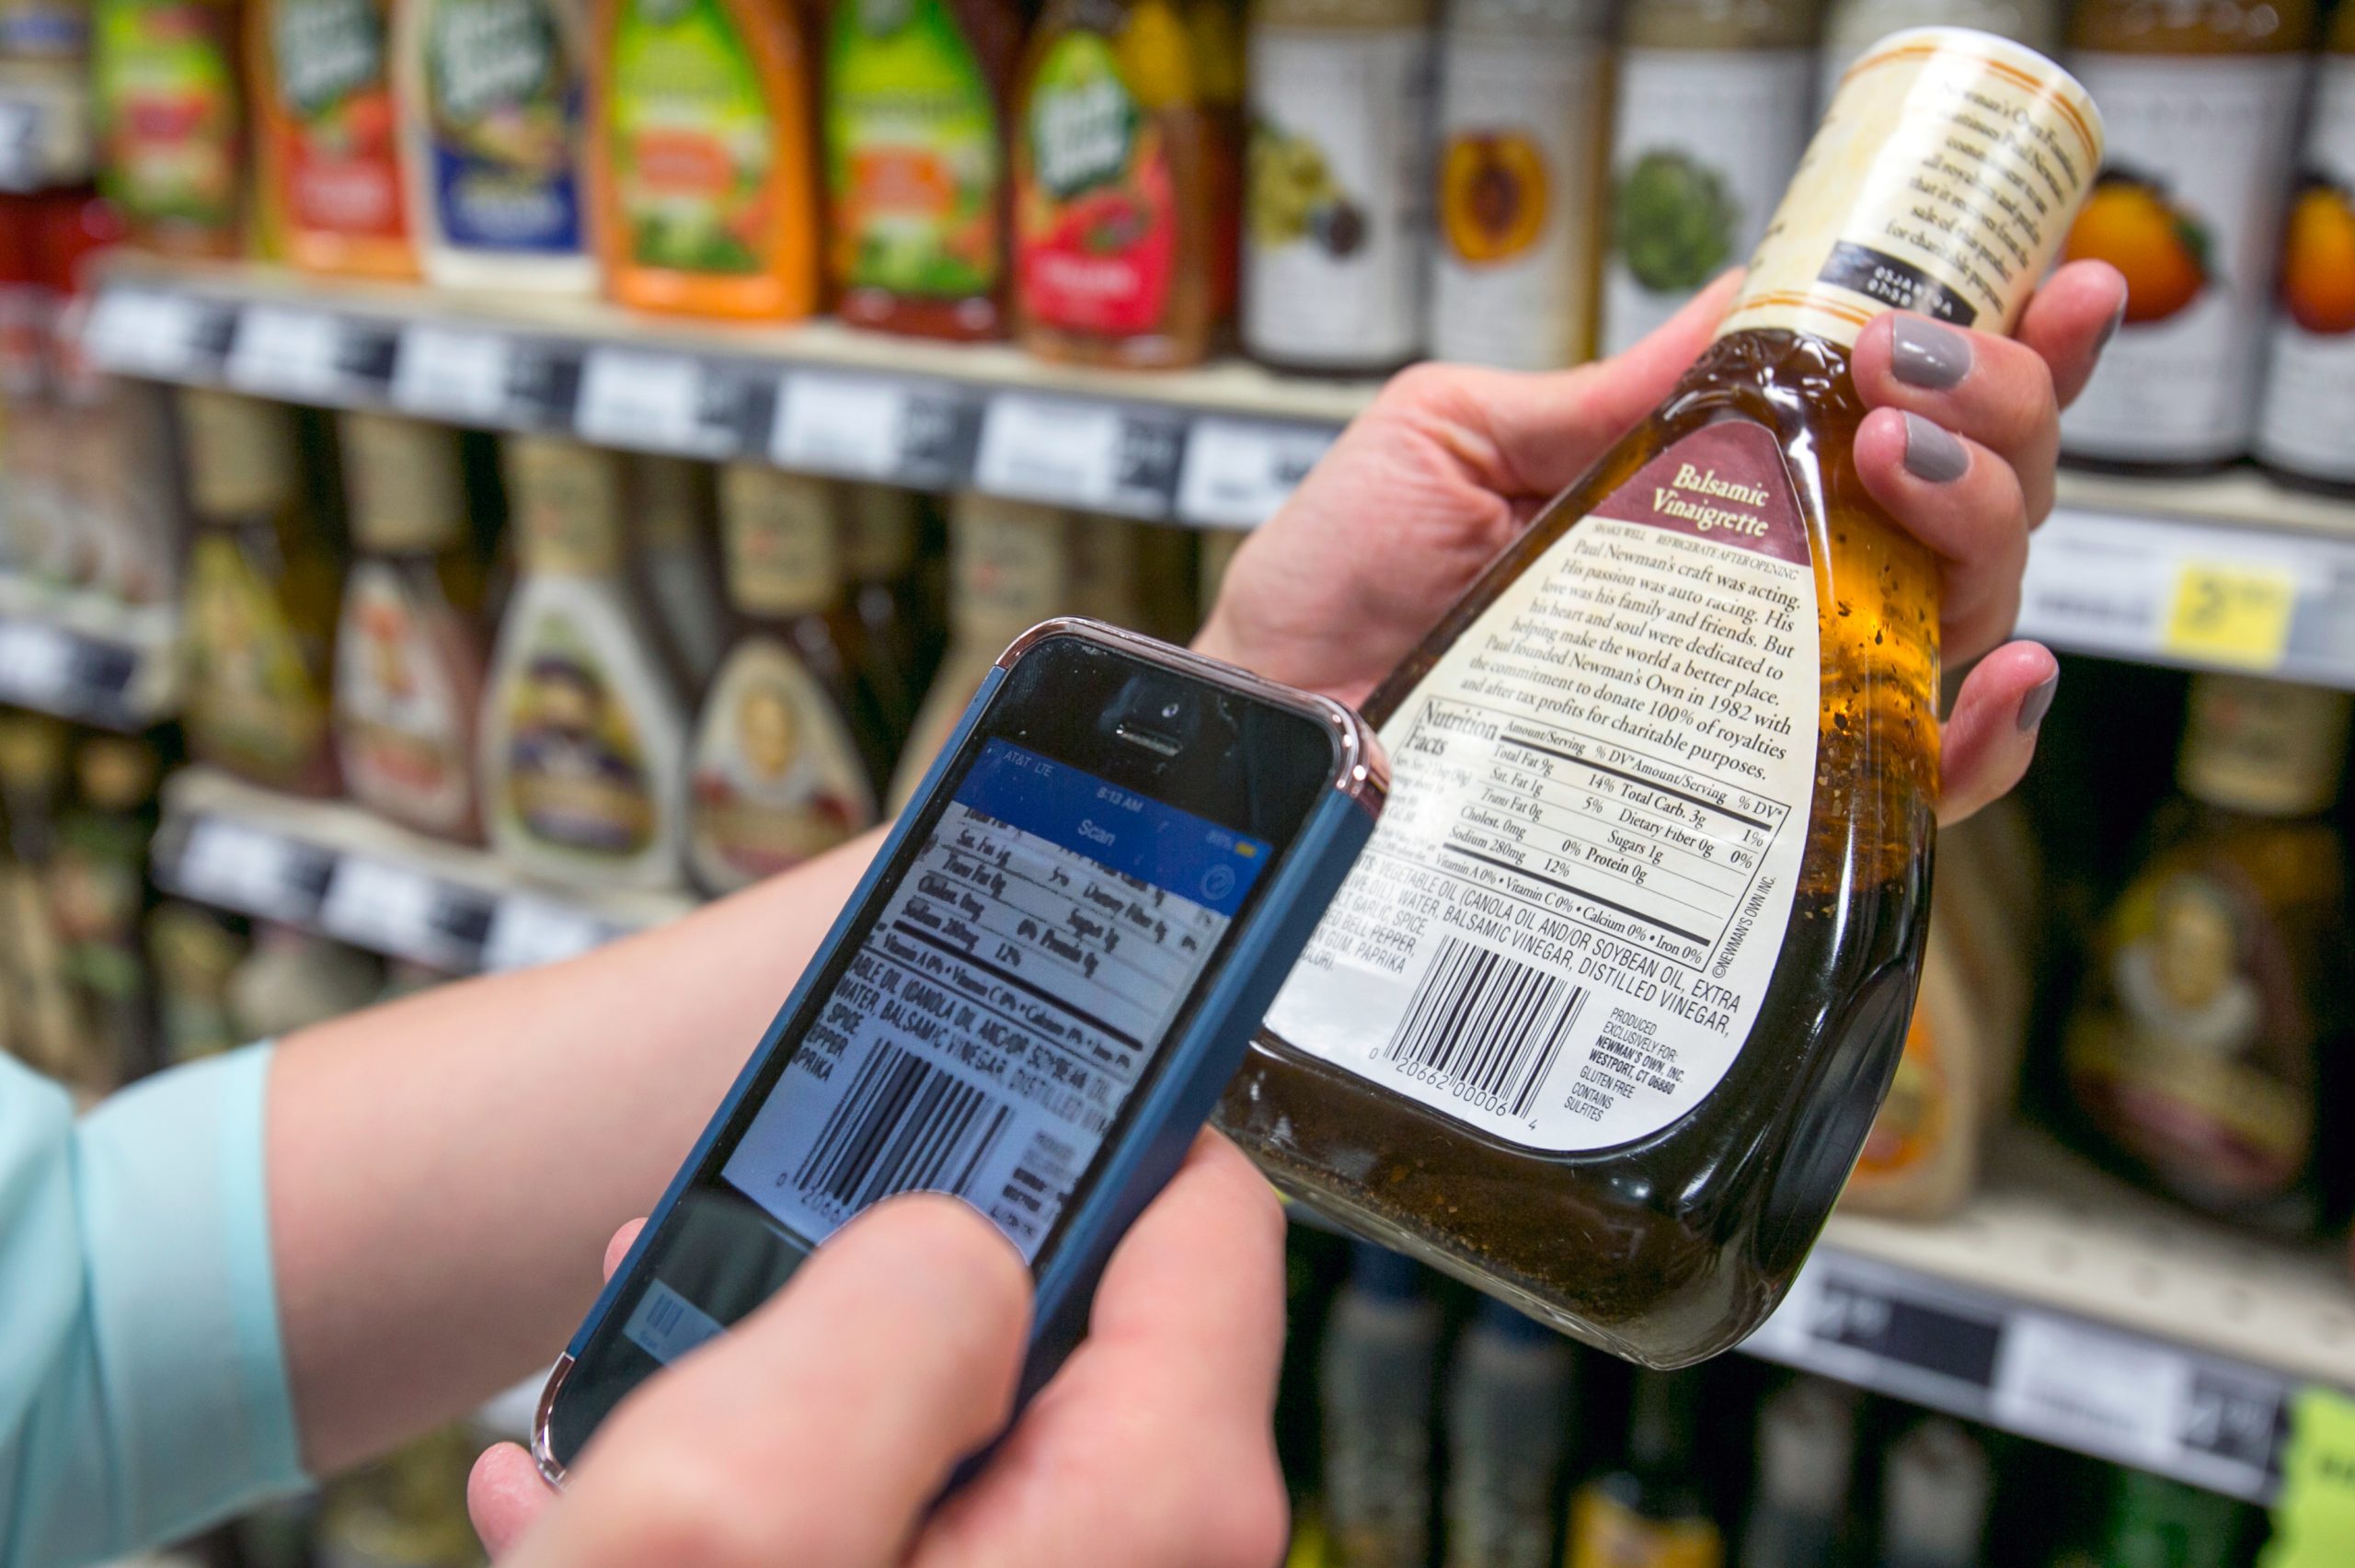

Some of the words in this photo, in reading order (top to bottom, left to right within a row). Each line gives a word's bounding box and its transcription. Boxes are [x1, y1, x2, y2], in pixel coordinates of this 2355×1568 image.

[1654, 487, 1769, 537] Vinaigrette
[1672, 464, 1769, 507] Balsamic
[1573, 538, 1604, 557] Paul
[1609, 544, 1675, 572] Newman's
[1677, 565, 1713, 583] craft
[1717, 575, 1746, 591] was
[1748, 586, 1800, 612] acting.
[1624, 527, 1645, 541] WELL
[1656, 534, 1717, 557] REFRIGERATE
[1720, 551, 1752, 567] AFTER
[1750, 559, 1799, 580] OPENING
[1560, 558, 1584, 576] His
[1583, 567, 1636, 594] passion
[1640, 579, 1665, 593] was
[1668, 587, 1703, 603] auto
[1706, 598, 1758, 625] racing.
[1764, 610, 1794, 632] His
[1570, 588, 1593, 601] was
[1595, 588, 1616, 605] his
[1618, 592, 1666, 622] family
[1666, 611, 1699, 627] and
[1699, 614, 1756, 647] friends.
[1763, 635, 1795, 658] But
[1511, 616, 1558, 647] helping
[1560, 630, 1597, 648] make
[1599, 636, 1623, 655] the
[1626, 647, 1672, 669] world
[1671, 662, 1681, 673] a
[1683, 659, 1733, 689] better
[1730, 680, 1779, 706] place.
[1529, 597, 1547, 613] his
[1549, 601, 1584, 623] heart
[1585, 612, 1615, 629] and
[1614, 621, 1648, 637] soul
[1648, 629, 1683, 647] were
[1685, 636, 1766, 674] dedicated
[1766, 666, 1784, 680] to
[1469, 655, 1489, 670] the
[1489, 664, 1575, 692] commitment
[1576, 682, 1591, 694] to
[1593, 683, 1645, 712] donate
[1648, 701, 1694, 725] 100%
[1696, 719, 1720, 735] of
[1716, 728, 1786, 760] royalties
[1485, 634, 1514, 653] Paul
[1512, 636, 1570, 666] founded
[1569, 652, 1642, 685] Newman's
[1646, 675, 1684, 699] Own
[1687, 687, 1705, 705] in
[1709, 695, 1752, 721] 1982
[1755, 714, 1791, 735] with
[1405, 724, 1446, 756] Facts
[1417, 697, 1499, 740] Nutrition
[1460, 677, 1488, 692] and
[1484, 681, 1515, 699] after
[1516, 692, 1536, 705] tax
[1535, 697, 1585, 718] profits
[1586, 705, 1610, 726] for
[1611, 715, 1688, 751] charitable
[1686, 745, 1765, 780] purposes.
[1003, 750, 1032, 767] AT&T
[1034, 761, 1053, 777] LTE
[1121, 796, 1143, 812] AM
[1505, 721, 1587, 755] Amount/Serving
[1632, 759, 1728, 806] Amount/Serving
[1738, 795, 1751, 810] %
[1490, 767, 1507, 784] Sat.
[1511, 773, 1528, 789] Fat
[1530, 780, 1544, 798] 1g
[1582, 796, 1603, 813] 5%
[1618, 808, 1663, 838] Dietary
[1664, 826, 1696, 847] Fiber
[1698, 839, 1715, 858] 0g
[1730, 851, 1752, 868] 0%
[1494, 745, 1522, 762] Total
[1522, 752, 1539, 768] Fat
[1542, 759, 1554, 777] 9g
[1589, 773, 1614, 792] 14%
[1621, 783, 1654, 806] Total
[1654, 796, 1685, 818] Carb.
[1689, 809, 1706, 830] 3g
[1742, 830, 1763, 847] 1%
[1077, 819, 1116, 846] Scan
[1450, 827, 1488, 849] Sodium
[1488, 839, 1526, 866] 280mg
[1544, 858, 1569, 877] 12%
[1461, 807, 1499, 829] Cholest.
[1502, 819, 1527, 842] 0mg
[1562, 840, 1580, 856] 0%
[1585, 847, 1629, 874] Protein
[1632, 864, 1648, 885] 0g
[1481, 787, 1510, 807] Trans
[1510, 796, 1528, 813] Fat
[1529, 803, 1543, 823] 0g
[1607, 830, 1646, 854] Sugars
[1648, 845, 1663, 865] 1g
[1393, 910, 1429, 938] SPICE,
[1437, 853, 1470, 876] Vitamin
[1469, 866, 1479, 878] A
[1479, 869, 1497, 885] 0%
[1507, 876, 1543, 901] Vitamin
[1545, 892, 1557, 905] C
[1555, 897, 1573, 912] 0%
[1583, 907, 1626, 933] Calcium
[1626, 924, 1646, 941] 0%
[1656, 934, 1680, 956] Iron
[1682, 946, 1702, 964] 0%
[1744, 897, 1763, 918] OWN
[1756, 876, 1776, 895] INC.
[1356, 942, 1407, 974] PAPRIKA
[1370, 928, 1417, 957] PEPPER,
[1398, 891, 1441, 920] WATER,
[1442, 905, 1511, 943] BALSAMIC
[1511, 930, 1574, 971] VINEGAR,
[1578, 956, 1658, 1001] DISTILLED
[1660, 990, 1729, 1036] VINEGAR,
[1438, 880, 1458, 901] OIL
[1459, 888, 1513, 921] (CANOLA
[1514, 908, 1536, 930] OIL
[1537, 918, 1591, 951] AND/OR
[1591, 938, 1660, 978] SOYBEAN
[1660, 966, 1684, 993] OIL,
[1691, 979, 1740, 1013] EXTRA
[1603, 1021, 1660, 1053] EXCLUSIVELY
[1657, 1045, 1678, 1062] FOR:
[1610, 1007, 1657, 1036] PRODUCED
[1580, 1065, 1614, 1089] GLUTEN
[1613, 1080, 1636, 1099] FREE
[1589, 1048, 1635, 1080] WESTPORT,
[1635, 1070, 1650, 1083] CT
[1648, 1075, 1675, 1094] 06880
[1595, 1035, 1643, 1063] NEWMAN'S
[1642, 1055, 1665, 1075] OWN,
[1666, 1066, 1684, 1082] INC.
[1369, 1047, 1379, 1059] 0
[1396, 1057, 1449, 1091] 20662
[1453, 1082, 1508, 1116] 00006
[1528, 1119, 1537, 1130] 4
[1564, 1096, 1604, 1122] SULFITES
[1571, 1082, 1614, 1109] CONTAINS
